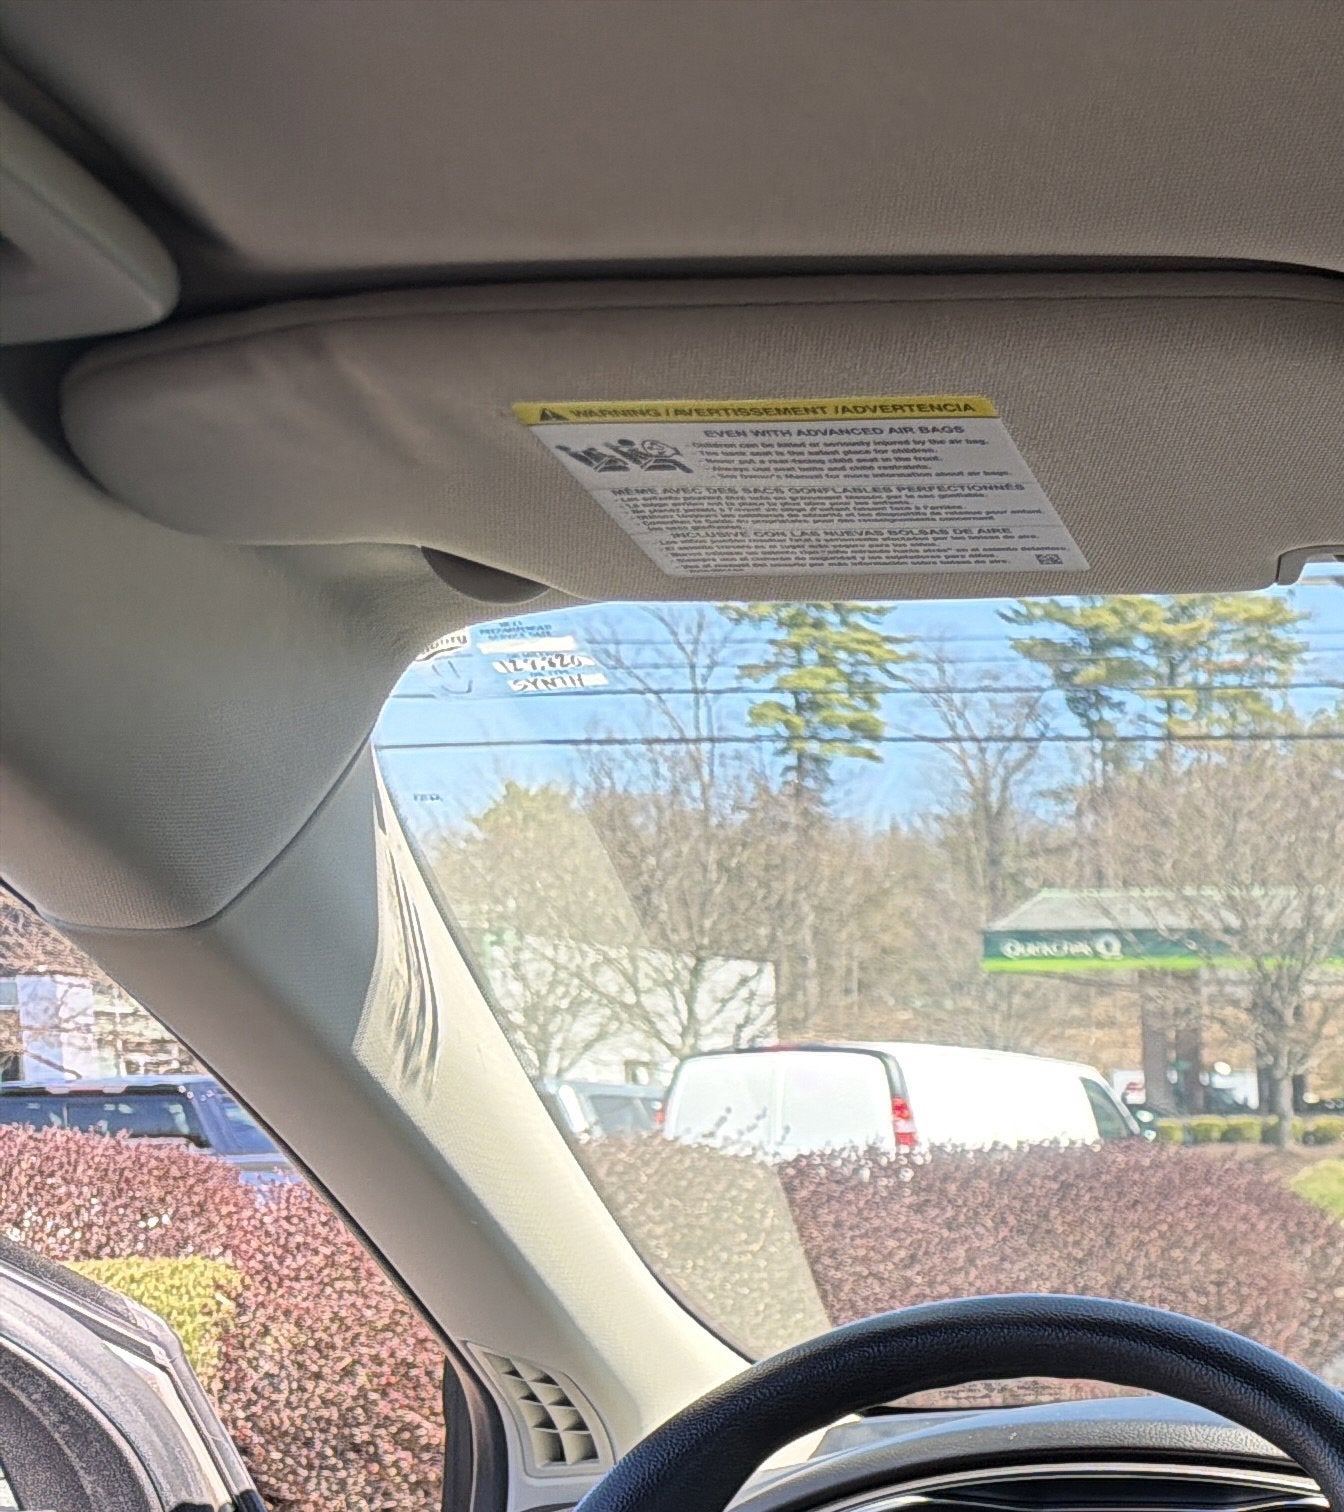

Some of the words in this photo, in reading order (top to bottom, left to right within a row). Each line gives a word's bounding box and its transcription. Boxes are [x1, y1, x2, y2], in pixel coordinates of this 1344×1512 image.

[570, 407, 661, 418] WARNING
[703, 429, 747, 438] EVEN
[751, 428, 793, 437] WITH
[797, 427, 883, 436] ADVANCED
[888, 426, 915, 435] AIR
[918, 425, 965, 434] BAGS
